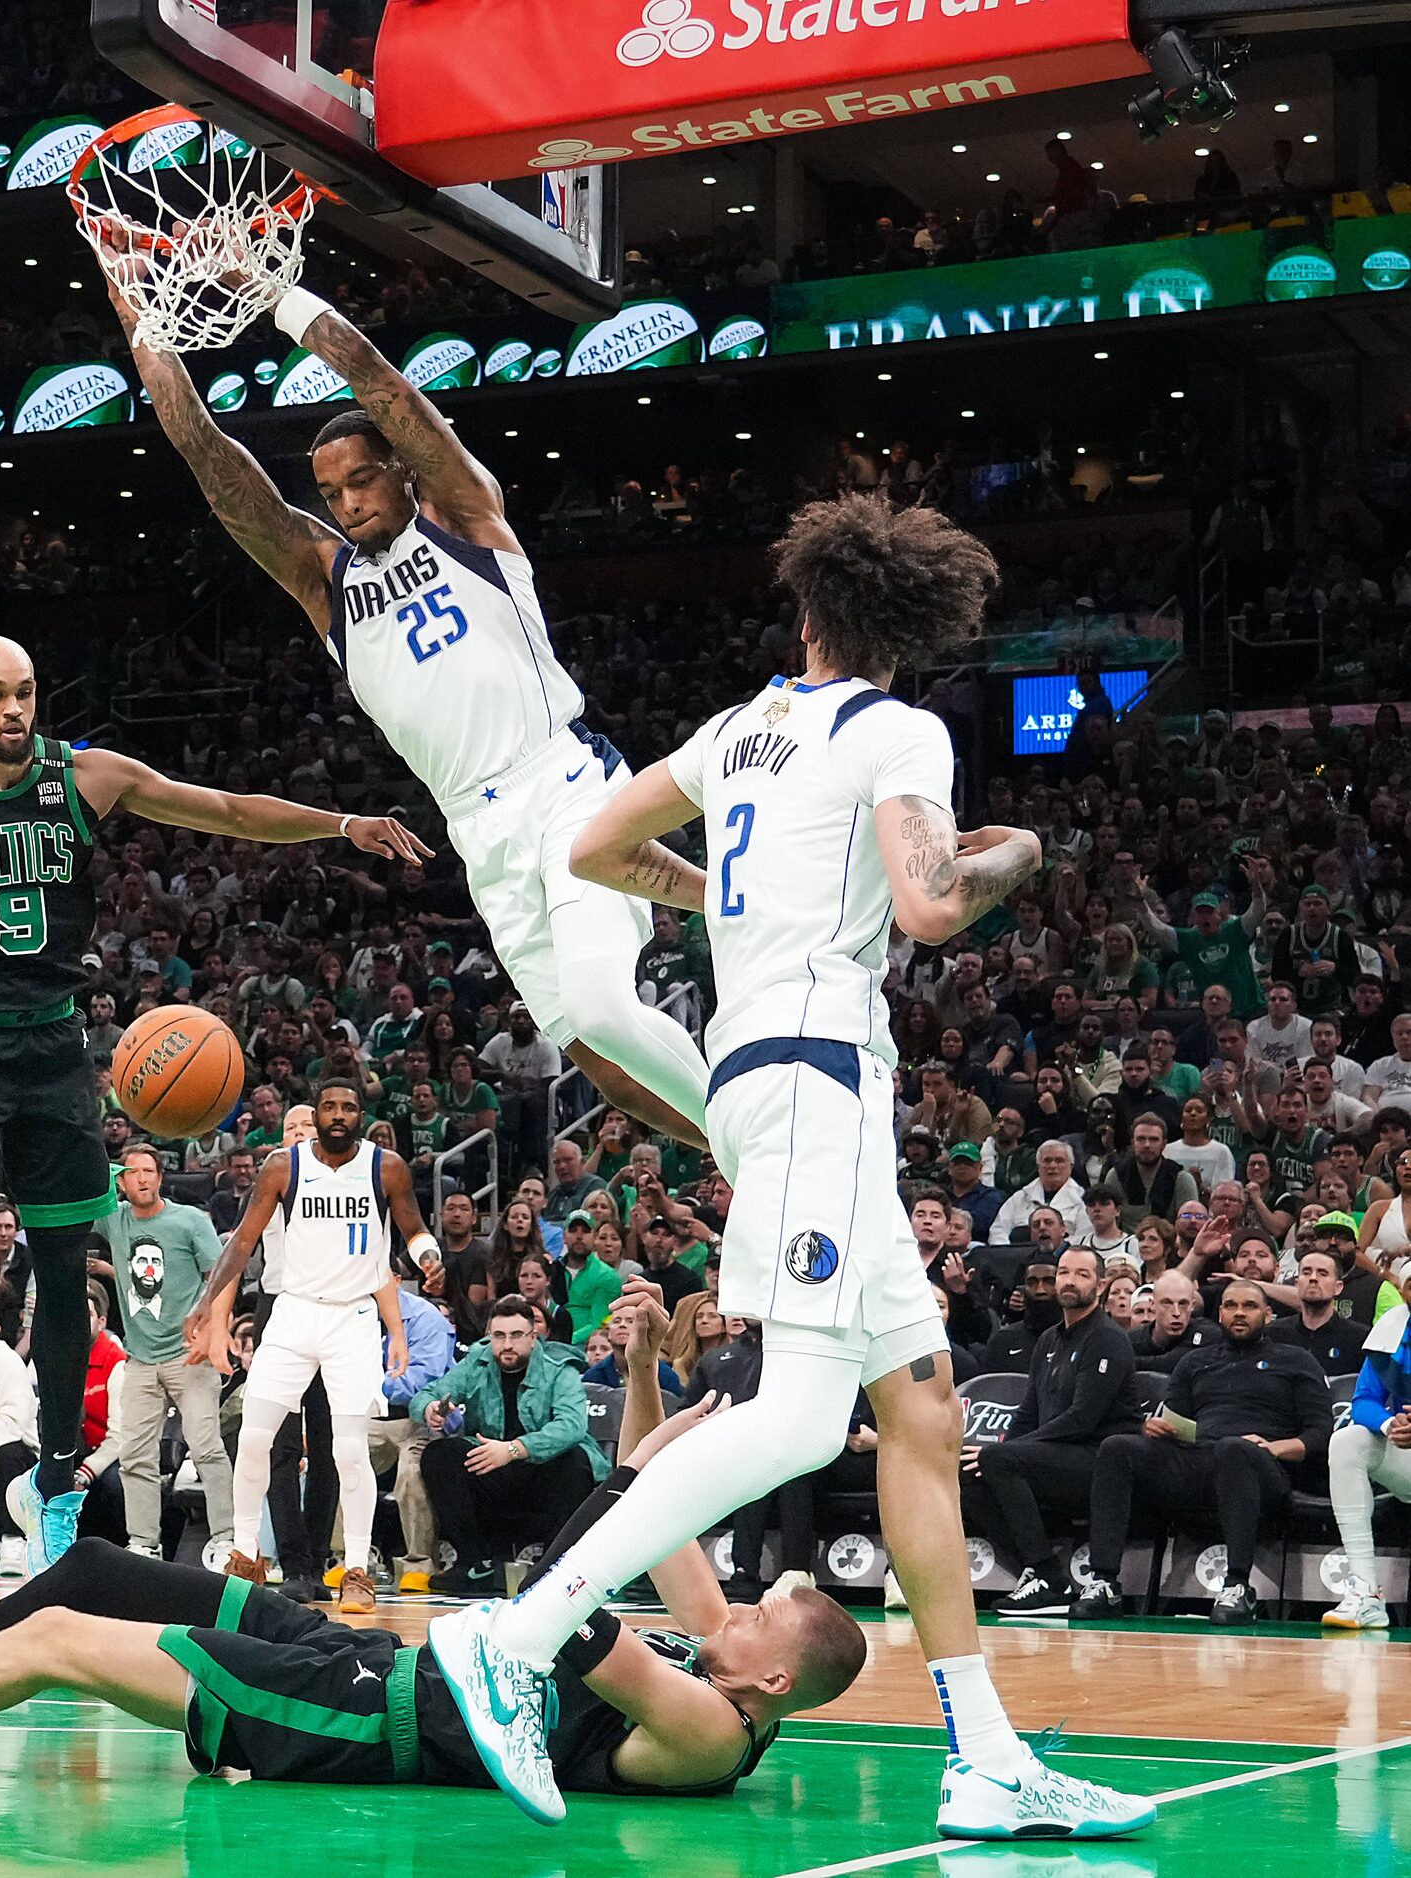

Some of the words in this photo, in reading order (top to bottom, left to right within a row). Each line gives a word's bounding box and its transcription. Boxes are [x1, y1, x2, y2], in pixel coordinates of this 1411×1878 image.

[16, 130, 93, 182] FRANKLIN
[578, 310, 673, 367] FRANKLIN
[410, 350, 469, 386] EMPLETON
[23, 372, 105, 424] FRANKLIN
[396, 583, 468, 665] 25
[1022, 714, 1073, 730] ARB
[1037, 731, 1069, 741] INS
[37, 781, 64, 796] VISTA
[39, 794, 65, 806] PRINT
[720, 802, 756, 917] 2
[302, 1197, 370, 1219] DALLAS
[346, 1223, 368, 1255] 11
[964, 1401, 1020, 1438] Fin
